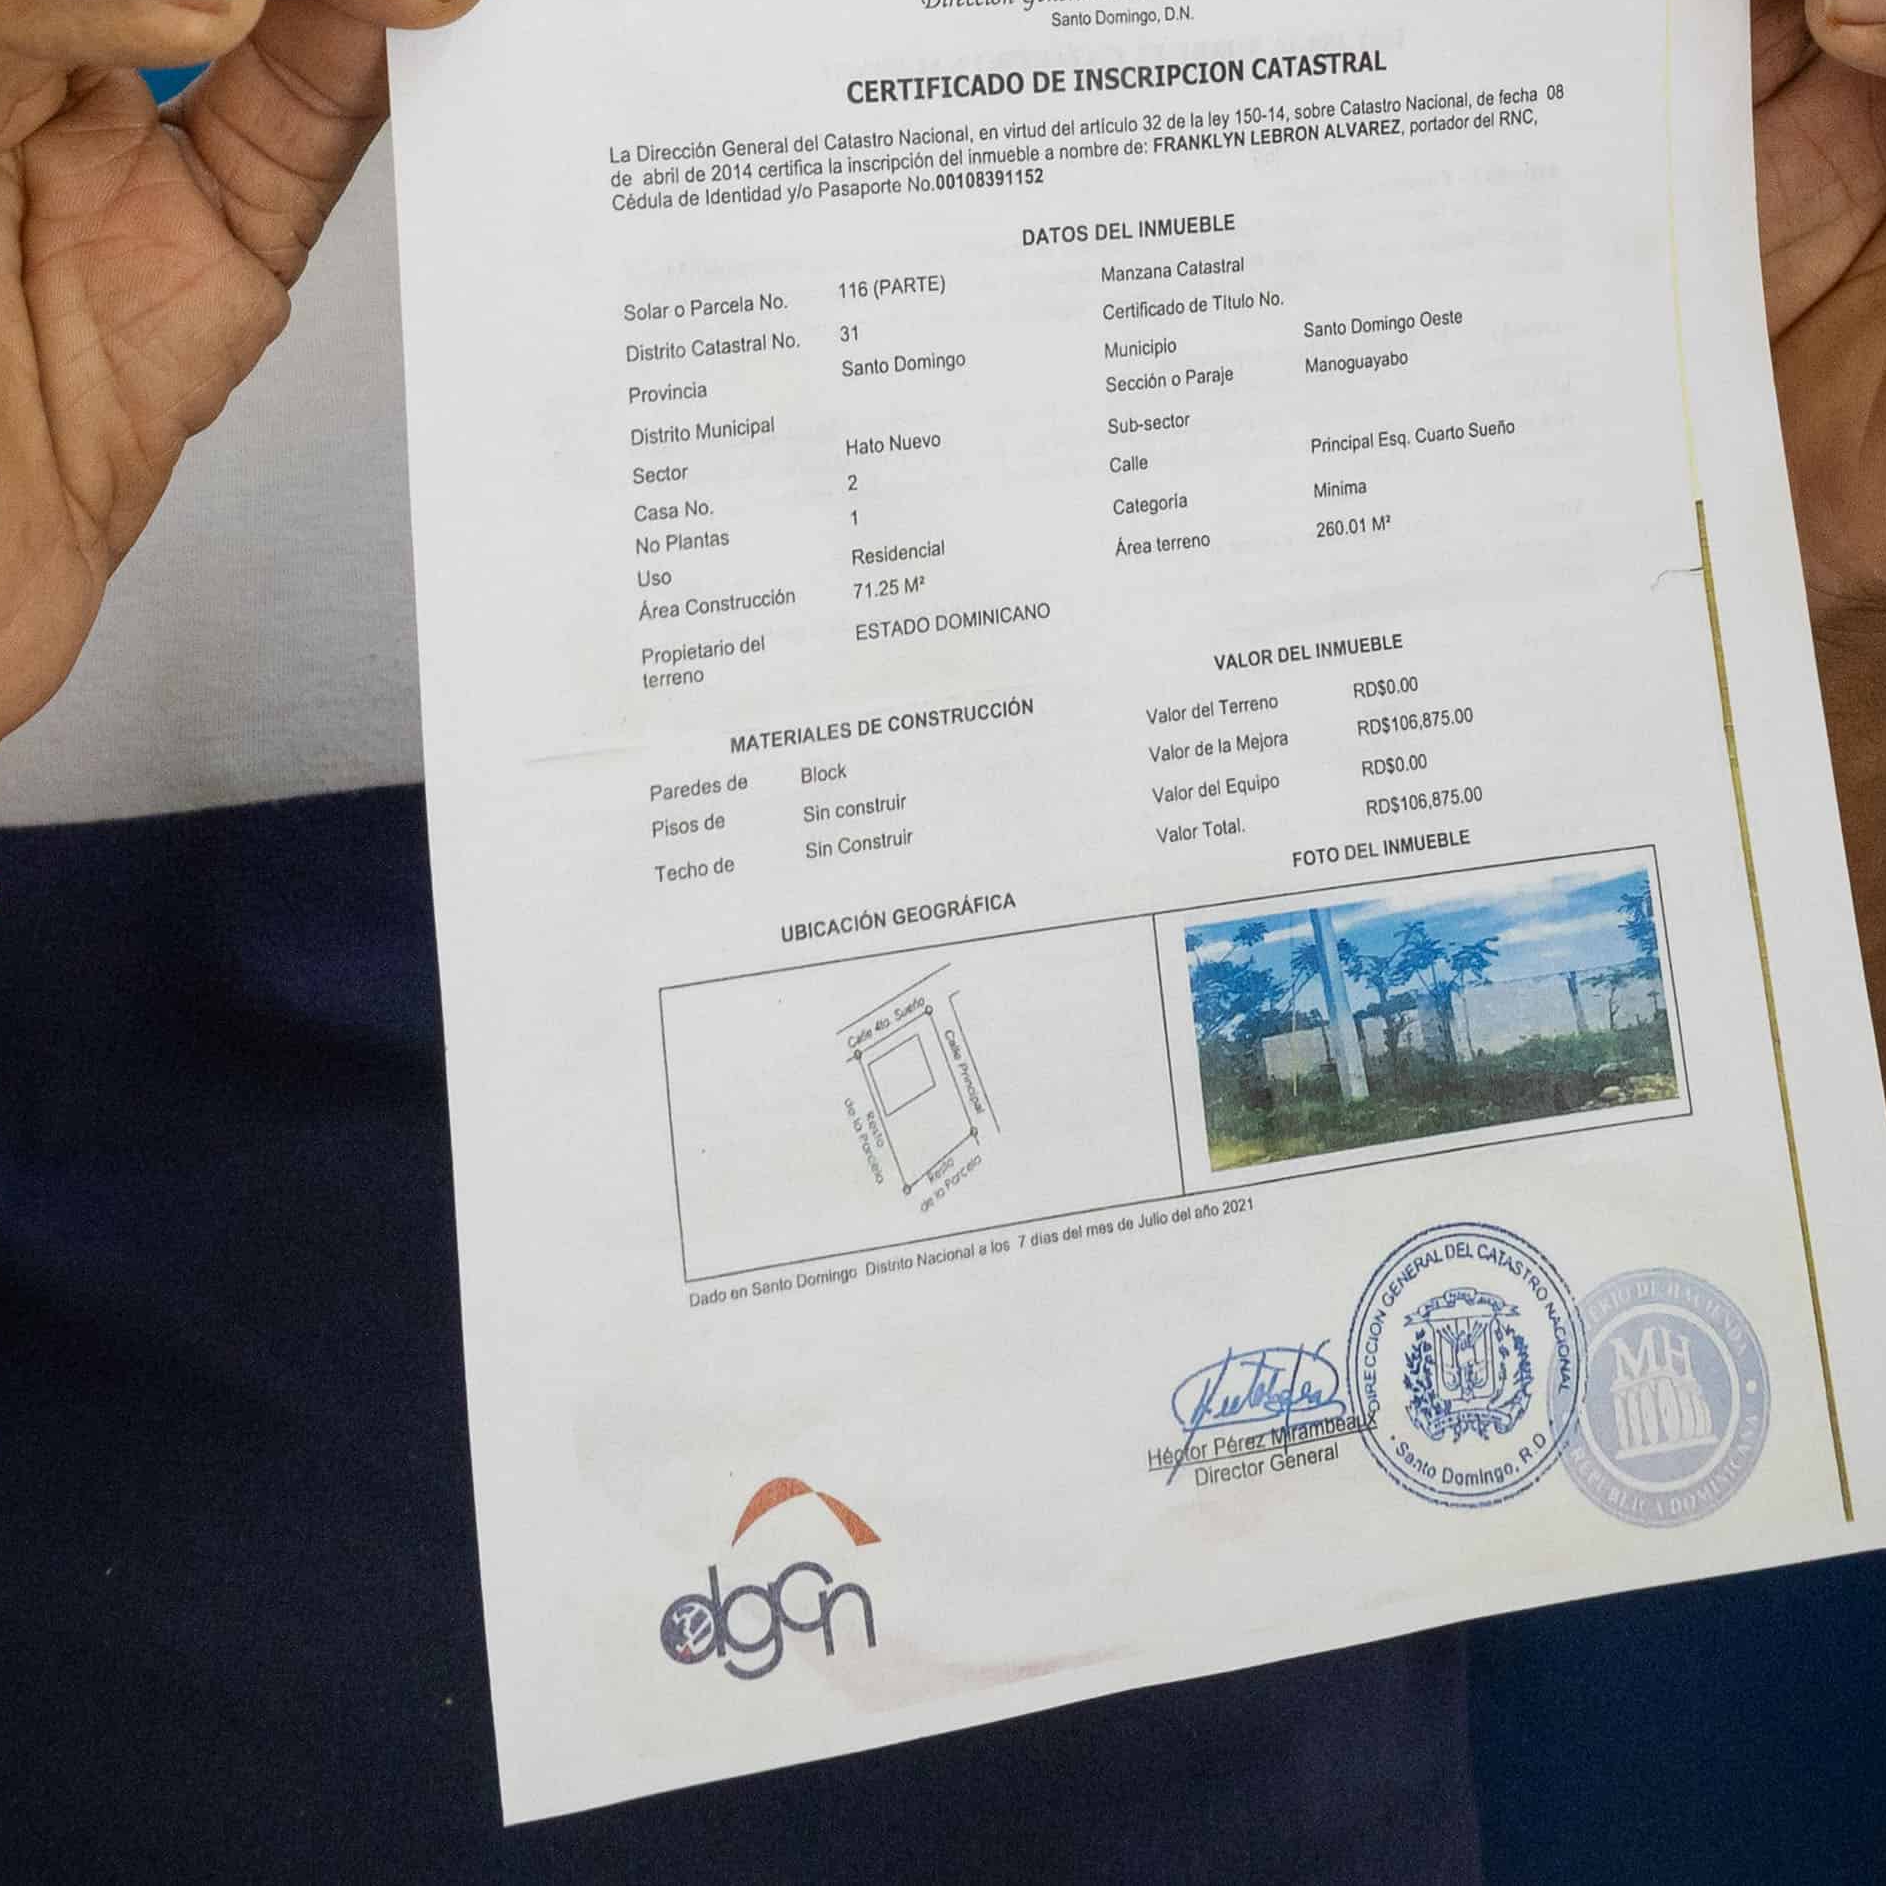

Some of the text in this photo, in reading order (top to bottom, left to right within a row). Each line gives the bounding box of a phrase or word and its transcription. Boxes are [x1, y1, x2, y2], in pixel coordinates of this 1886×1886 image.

[1051, 5, 1194, 27] Santo Domingo, D.N.
[846, 49, 1386, 103] CERTIFICADO DE INSCRIPCION CATASTRAL
[611, 191, 672, 211] Cédula
[678, 189, 699, 207] de
[705, 184, 781, 205] Identidad
[786, 182, 812, 204] y/o
[818, 178, 901, 199] Pasaporte
[1022, 213, 1234, 246] DATOS DEL INMUEBLE
[1101, 256, 1244, 282] Manzana Catastral
[838, 274, 945, 300] 116 (PARTE)
[623, 293, 788, 321] Solar o Parcela No.
[1102, 298, 1185, 320] Certificado
[1188, 297, 1207, 313] de
[1259, 290, 1283, 306] No.
[839, 324, 857, 342] 31
[1303, 309, 1462, 337] Santo Domingo Oeste
[626, 331, 800, 362] Distrito Catastral No.
[1104, 337, 1176, 358] Municipio
[841, 352, 965, 377] Santo Domingo
[1305, 351, 1408, 373] Manoguayabo
[1105, 365, 1233, 392] Sección o Paraje
[628, 381, 707, 404] Provincia
[630, 415, 774, 446] Distrito Municipal
[1107, 413, 1190, 434] Sub-sector
[1311, 419, 1514, 454] Principal Esq. Cuarto Sueño
[845, 434, 941, 456] Hato Nuevo
[632, 465, 688, 484] Sector
[1109, 455, 1148, 473] Calle
[847, 473, 857, 490] 2
[634, 499, 713, 522] Casa No.
[850, 509, 857, 525] 1
[1316, 517, 1365, 538] 260.01
[635, 531, 729, 554] No Plantas
[851, 539, 944, 565] Residencial
[1115, 534, 1210, 556] Área terreno
[637, 569, 671, 587] Uso
[853, 578, 899, 599] 71.25
[638, 588, 795, 621] Área Construcción
[855, 602, 1050, 640] ESTADO DOMINICANO
[641, 634, 764, 666] Propietario del
[1213, 633, 1402, 670] VALOR DEL INMUEBLE
[642, 669, 704, 689] terreno
[1353, 675, 1418, 698] RD$0.00
[1145, 696, 1278, 724] Valor del Terreno
[1356, 706, 1473, 736] RD$106,875.00
[730, 695, 1033, 753] MATERIALES DE CONSTRUCCIÓN
[1148, 732, 1288, 762] Valor de la Mejora
[800, 762, 846, 784] Block
[1361, 753, 1427, 776] RD$0.00
[649, 773, 747, 802] Paredes de
[1151, 773, 1279, 803] Valor del Equipo
[1365, 785, 1482, 816] RD$106,875.00
[803, 793, 906, 822] Sin construir
[652, 812, 725, 838] Pisos de
[1155, 817, 1245, 842] Valor Total.
[805, 828, 912, 858] Sin Construir
[1292, 828, 1470, 867] FOTO DEL INMUEBLE
[654, 857, 734, 882] Techo de
[780, 892, 1016, 942] UBICACIÓN GEOGRÁFICA
[1147, 1410, 1378, 1468] Héctor Pérez Mirambeaux
[1195, 1442, 1338, 1487] Director General
[1395, 1441, 1436, 1479] Santo
[1441, 1463, 1520, 1487] Domingo,
